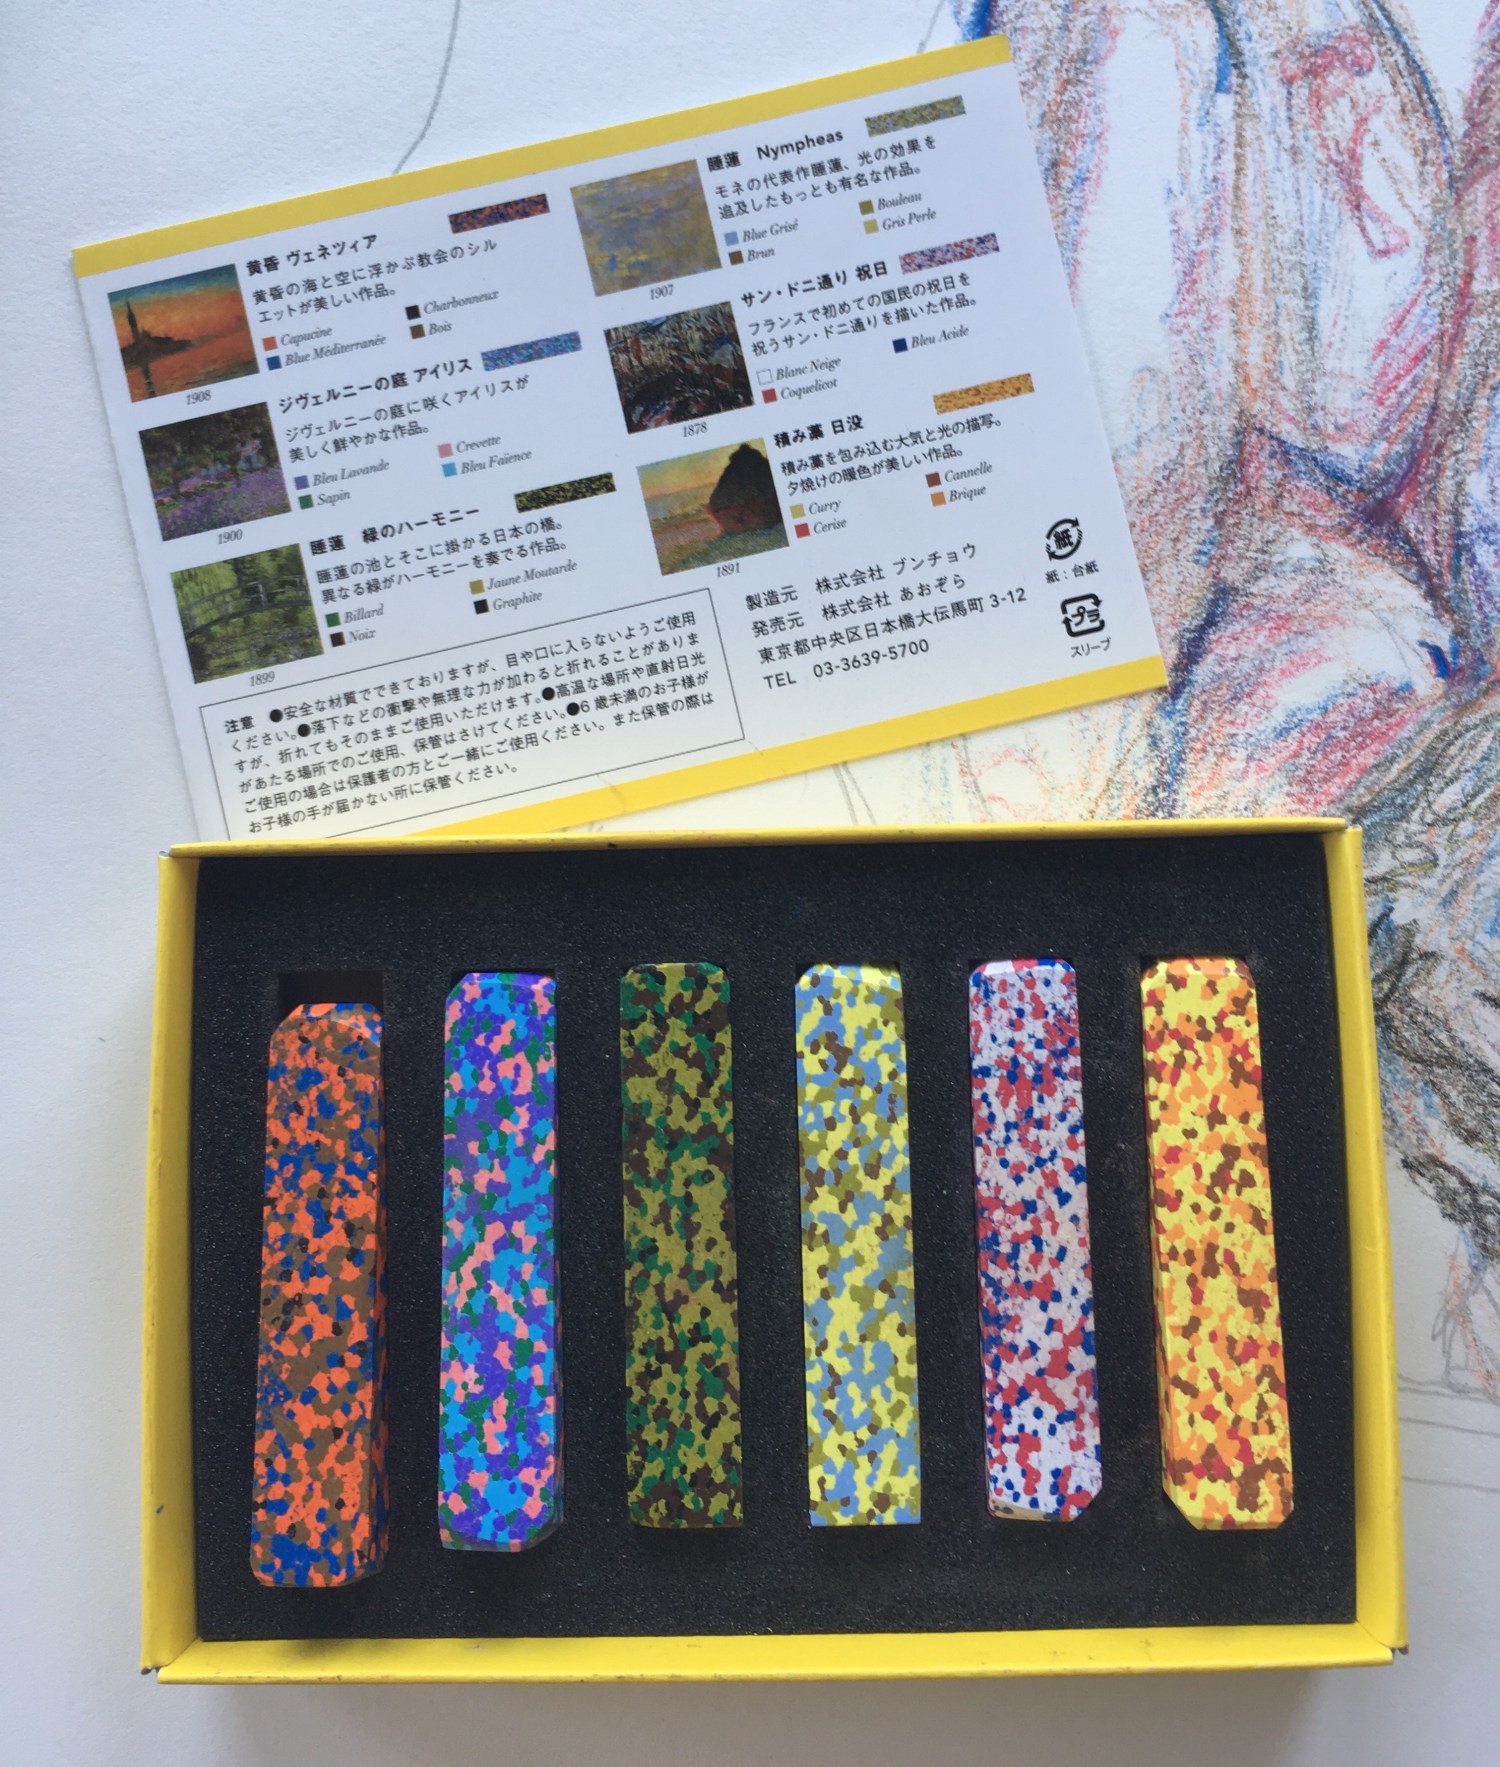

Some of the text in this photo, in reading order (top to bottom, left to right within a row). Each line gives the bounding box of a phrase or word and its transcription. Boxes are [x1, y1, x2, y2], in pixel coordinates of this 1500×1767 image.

[757, 131, 844, 161] Nympheas
[878, 192, 922, 210] Bouleau
[742, 219, 799, 242] Blue Grisé
[882, 209, 936, 231] Gris Perle
[246, 235, 377, 276] 黄昏 ヴェネツィア
[748, 248, 774, 262] Brun
[252, 239, 497, 305] 黄昏の海と空に浮かぶ教会のシル
[856, 261, 888, 281] 祝日
[259, 283, 396, 323] エットが美しい作品。
[424, 289, 499, 315] Charbonneux
[650, 285, 674, 300] 1907
[749, 272, 970, 335] フランスで初めての国民の祝日を
[281, 327, 333, 348] Capucine
[429, 323, 452, 335] Bois
[911, 325, 969, 348] Bleu Acide
[285, 334, 387, 366] Blue Méditerranée
[776, 356, 841, 380] Blanc Neige
[279, 358, 472, 413] ジヴェルニーの庭 アイリス
[780, 378, 838, 401] Coquelicot
[186, 390, 211, 405] 1908
[683, 422, 708, 437] 1878
[832, 414, 864, 435] 日没
[289, 421, 429, 463] 美しく鮮やかな作品。
[456, 435, 501, 453] Crevette
[313, 459, 389, 486] Bleu Lavande
[461, 460, 486, 475] Bleu
[945, 462, 992, 482] Cannelle
[317, 490, 350, 507] Sapin
[949, 485, 986, 504] Brique
[809, 500, 841, 515] Curry
[218, 529, 243, 544] 1900
[362, 509, 479, 544] 緑のハーモニー
[813, 519, 847, 534] Cerise
[487, 560, 578, 590] Jaune Moutarde
[717, 562, 740, 578] 1891
[745, 541, 977, 612] 製造元 株式会社 ブンチョウ
[492, 591, 542, 612] Graphite
[751, 573, 966, 638] 発売元 株式会社 あおぞら
[344, 604, 384, 623] Billard
[349, 629, 376, 643] Noix
[758, 587, 1027, 665] 東京都中央区日本橋大伝馬町 3-12
[1071, 638, 1112, 658] スリーブ
[763, 638, 929, 690] TEL 03-3639-5700
[250, 671, 275, 687] 1899
[225, 716, 254, 734] 注意
